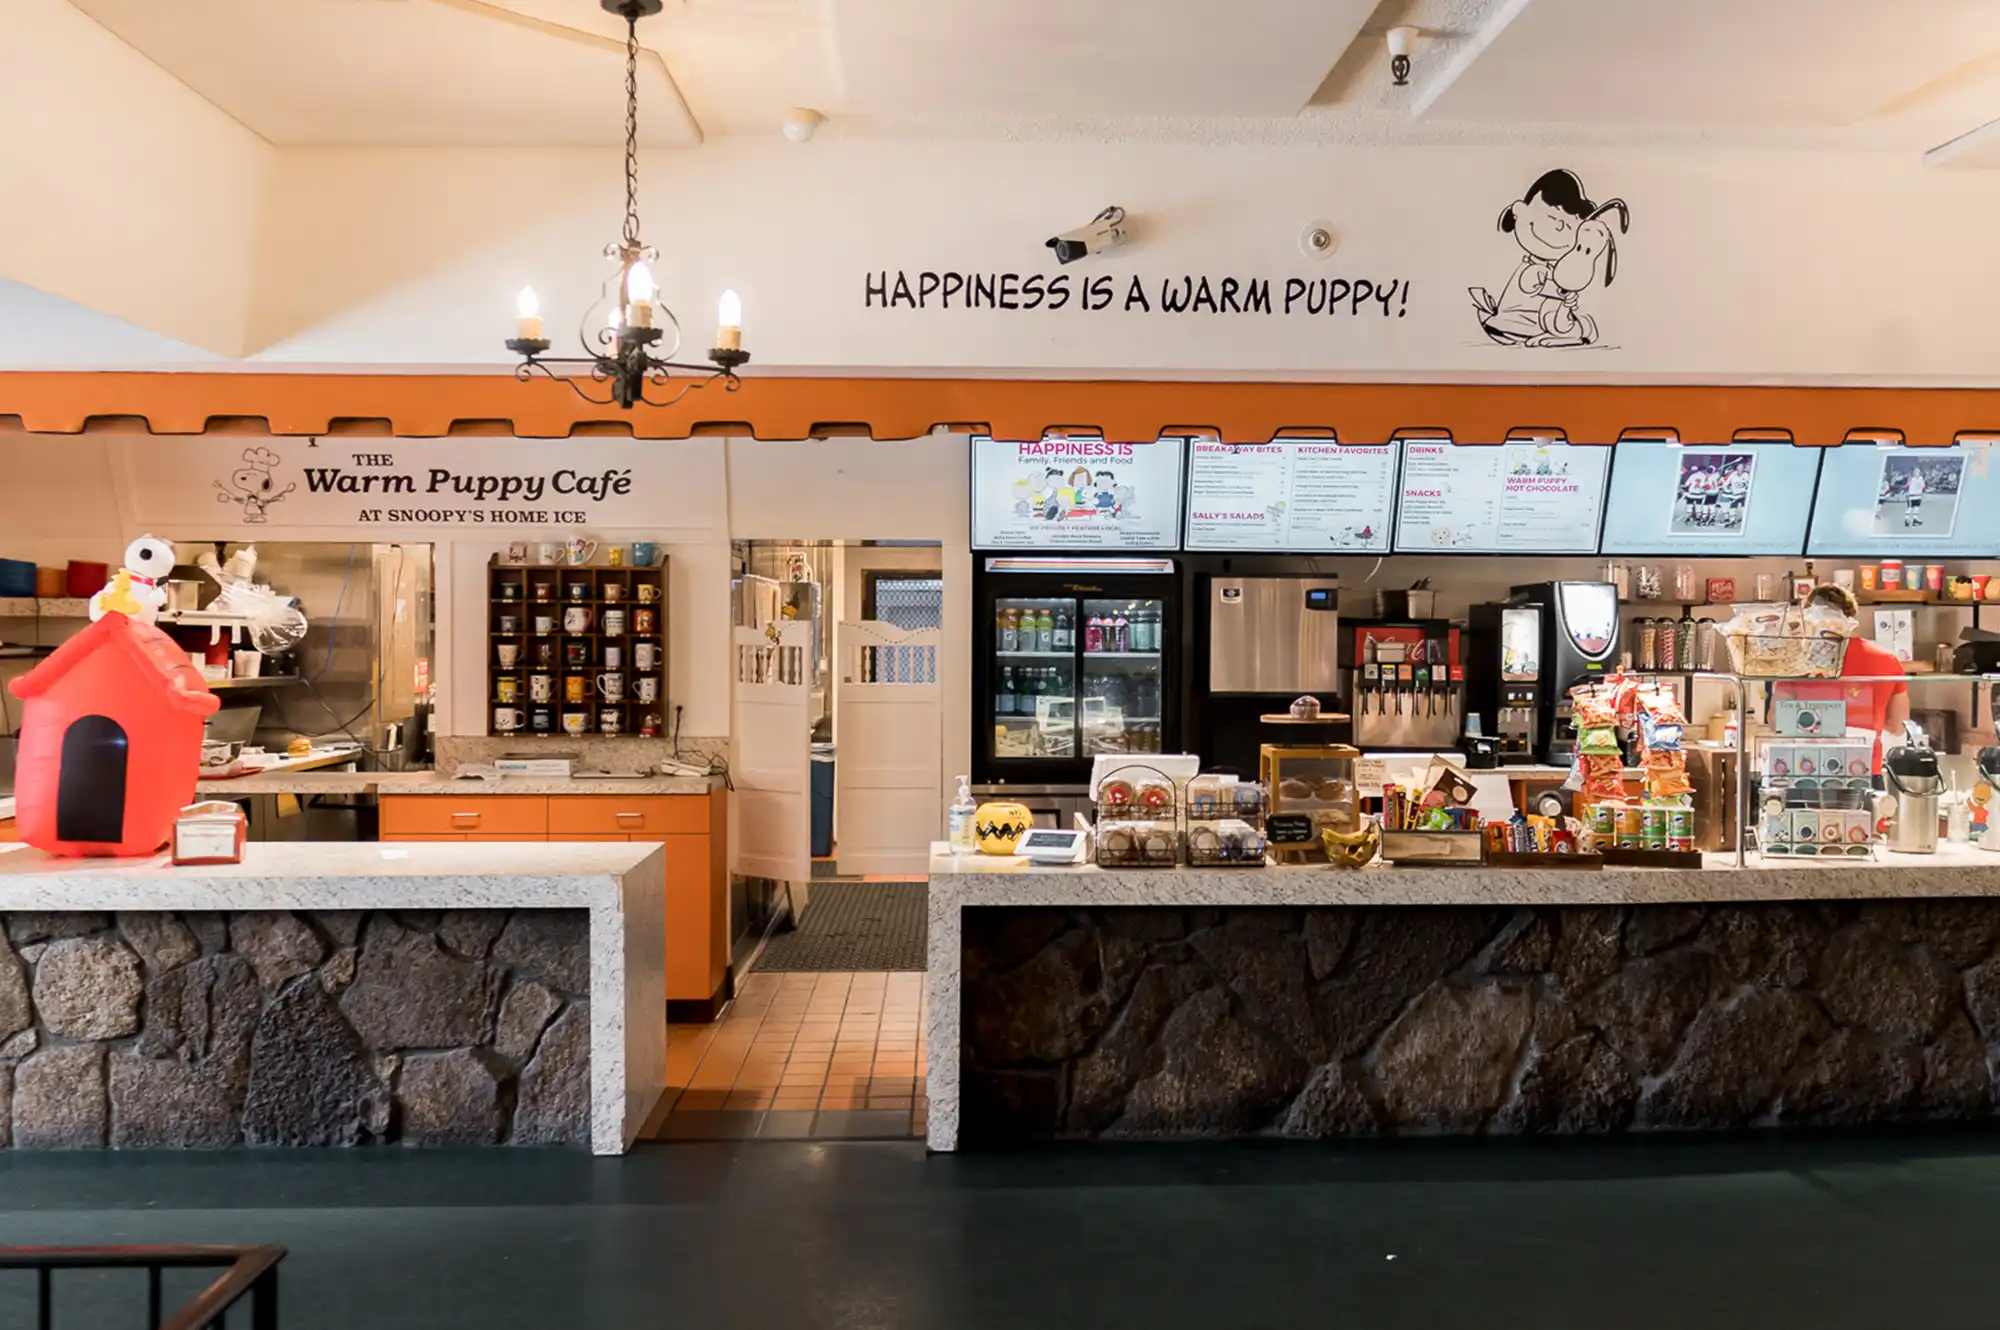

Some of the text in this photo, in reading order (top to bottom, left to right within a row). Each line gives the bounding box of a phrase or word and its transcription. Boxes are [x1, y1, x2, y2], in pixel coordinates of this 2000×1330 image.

[865, 270, 1410, 318] HAPPINESS IS A WARM PUPPY!
[1018, 443, 1134, 456] HAPPINESS IS
[1339, 447, 1389, 455] FAVORITES
[1409, 446, 1444, 454] DRINKS
[352, 453, 393, 467] THE
[1018, 456, 1134, 466] Family, Friends and Food
[303, 468, 632, 501] Warm Puppy Café
[1537, 477, 1568, 485] PUPPY
[1405, 489, 1442, 497] SNACKS
[358, 509, 587, 524] AT SNOOPY'S HOME ICE
[1192, 512, 1265, 520] SALLY'S SALADS
